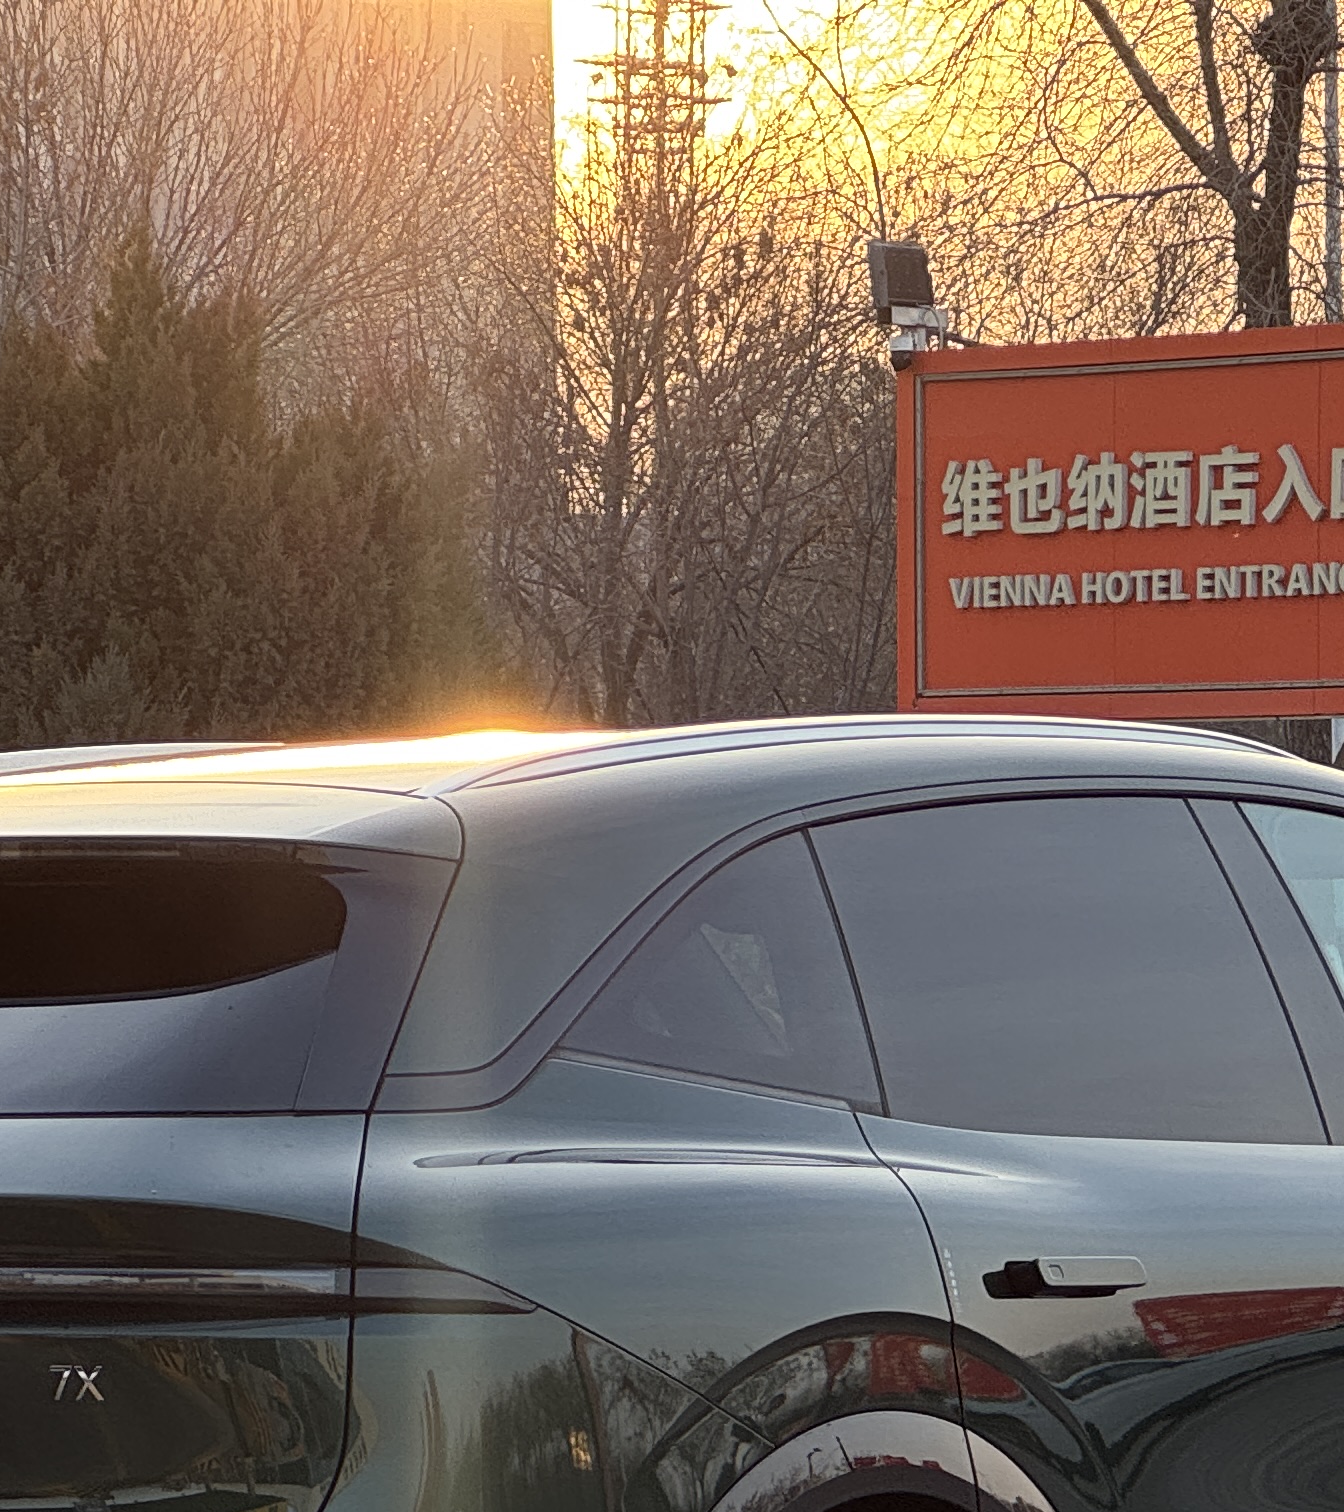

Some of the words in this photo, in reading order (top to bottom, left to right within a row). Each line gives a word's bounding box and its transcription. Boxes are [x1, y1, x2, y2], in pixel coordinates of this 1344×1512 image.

[948, 573, 1077, 610] VIENNA
[1081, 568, 1191, 604] HOTEL
[49, 1364, 105, 1401] 7X
